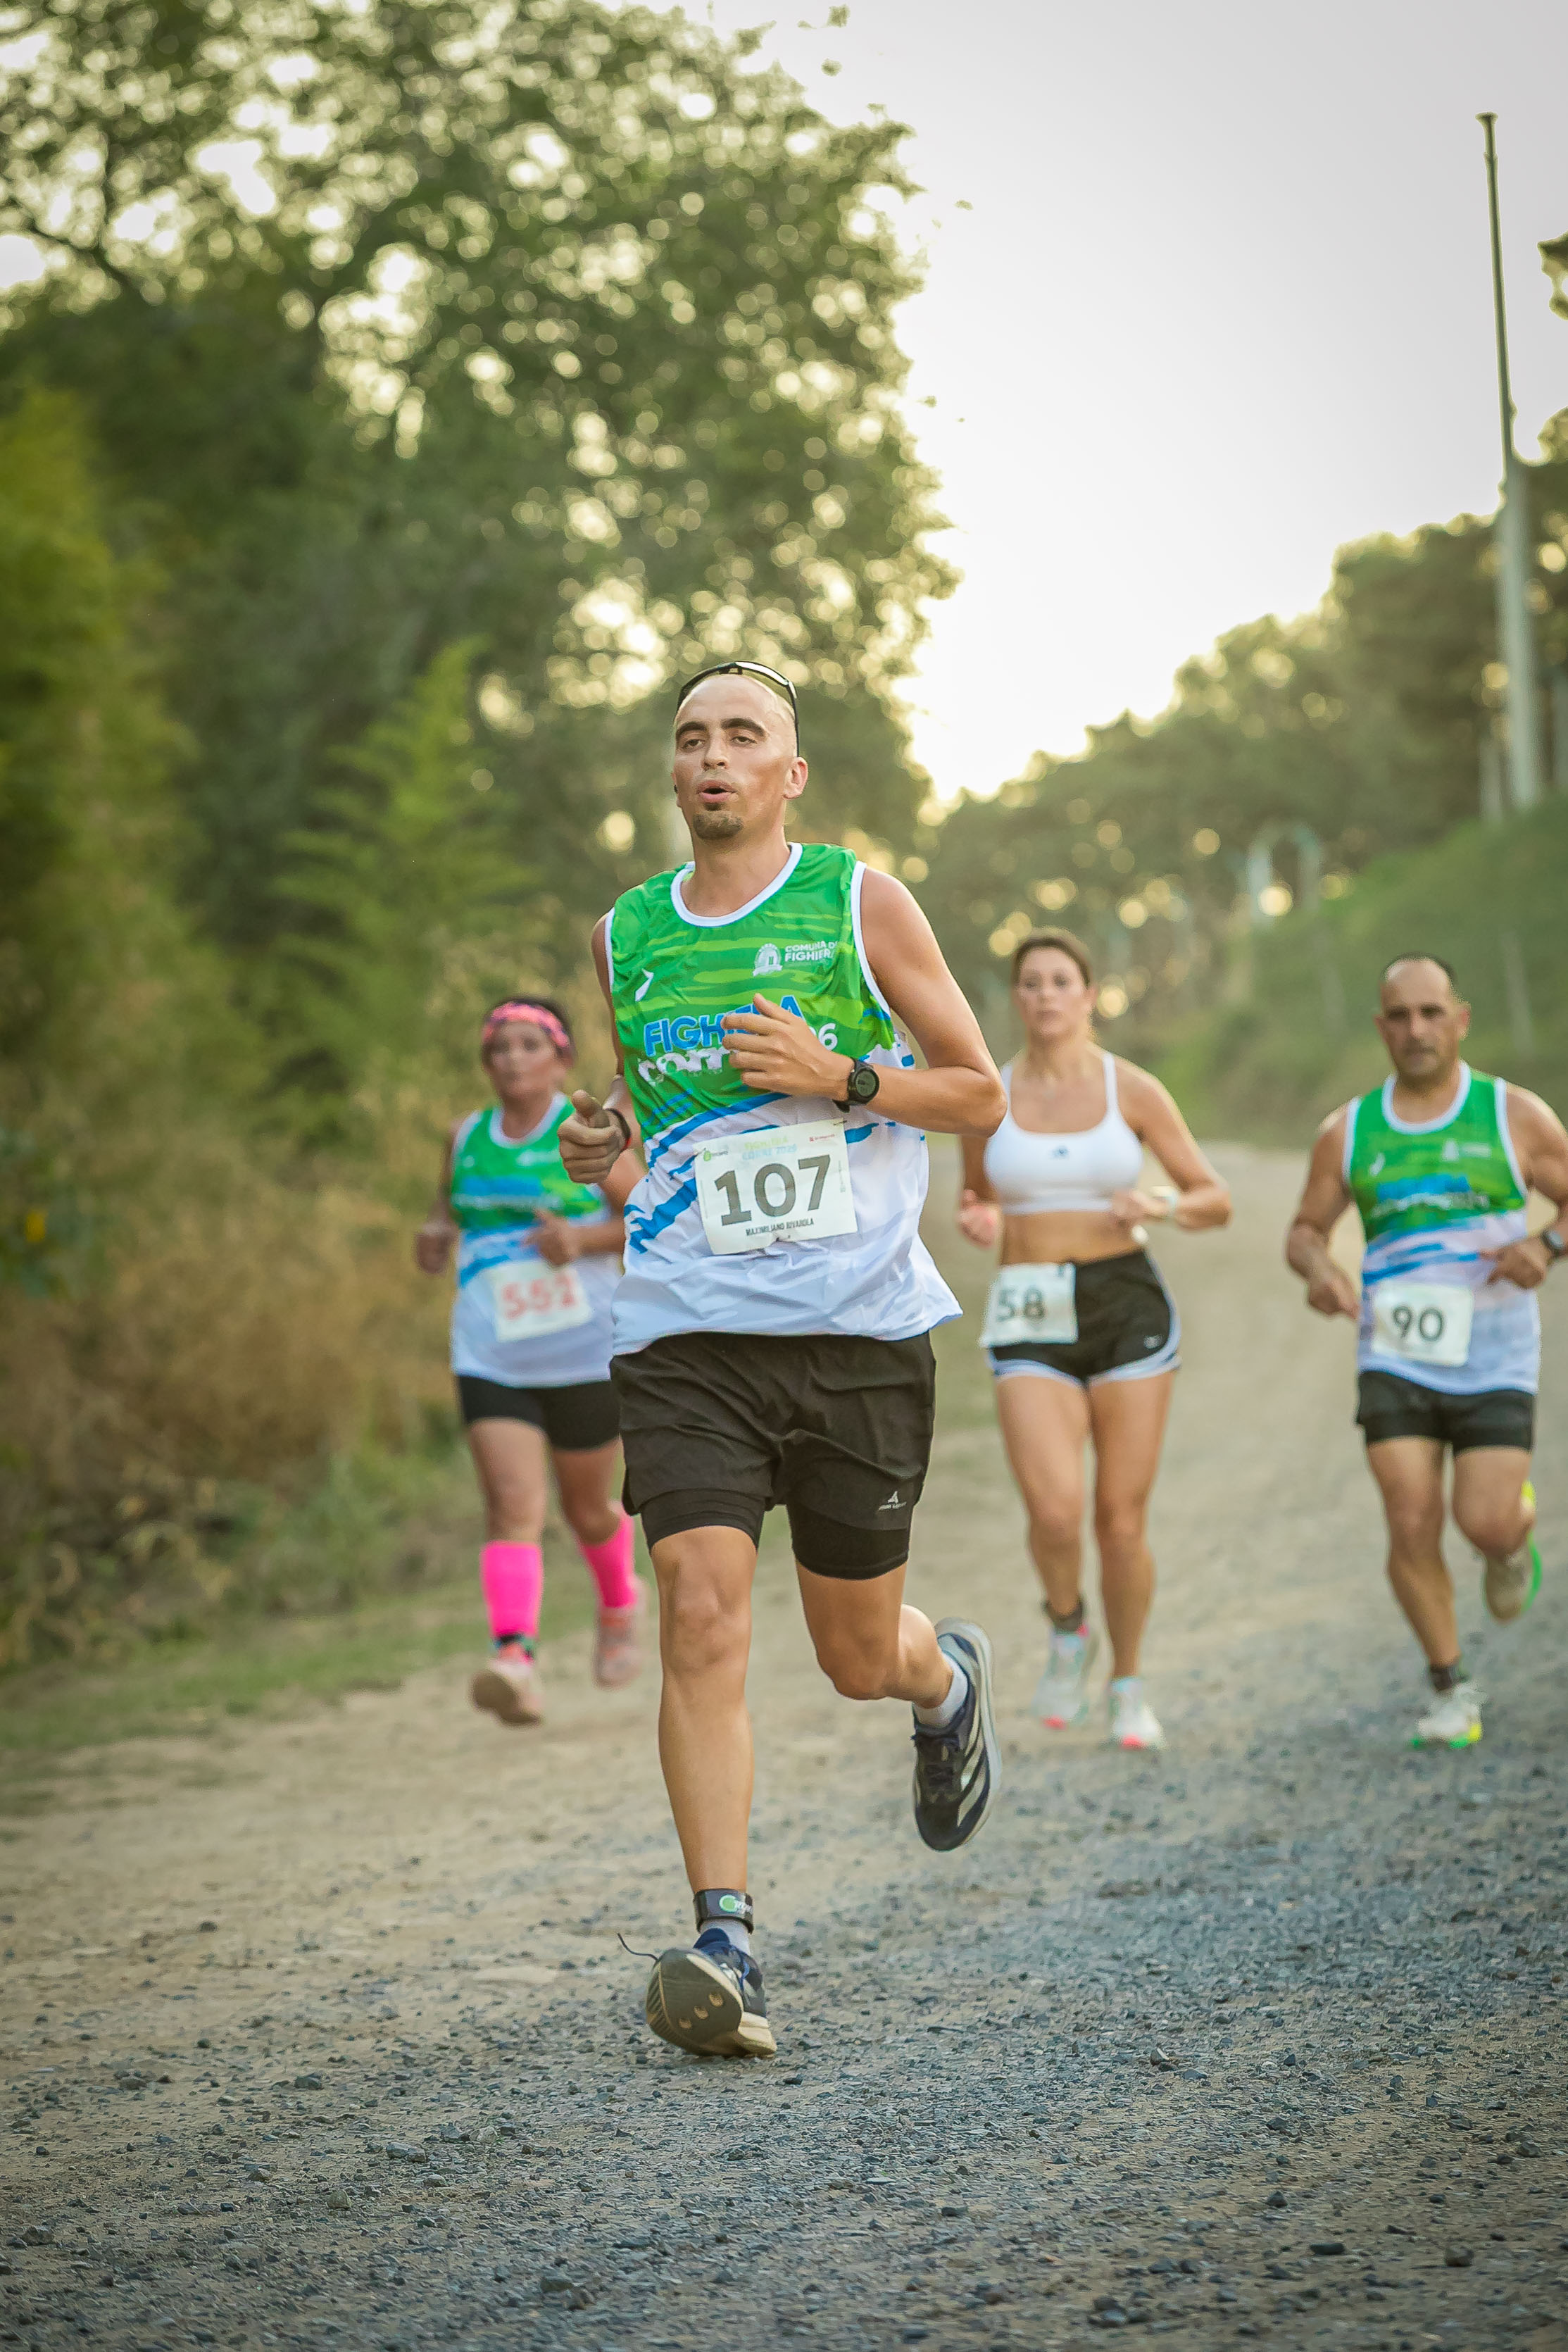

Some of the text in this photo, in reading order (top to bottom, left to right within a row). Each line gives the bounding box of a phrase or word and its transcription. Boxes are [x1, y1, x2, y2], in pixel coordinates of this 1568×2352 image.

[784, 941, 827, 953] COMUNA
[784, 949, 836, 962] FIGHIER
[714, 1154, 831, 1226] 107
[996, 1285, 1046, 1322] 58
[1391, 1305, 1445, 1342] 90
